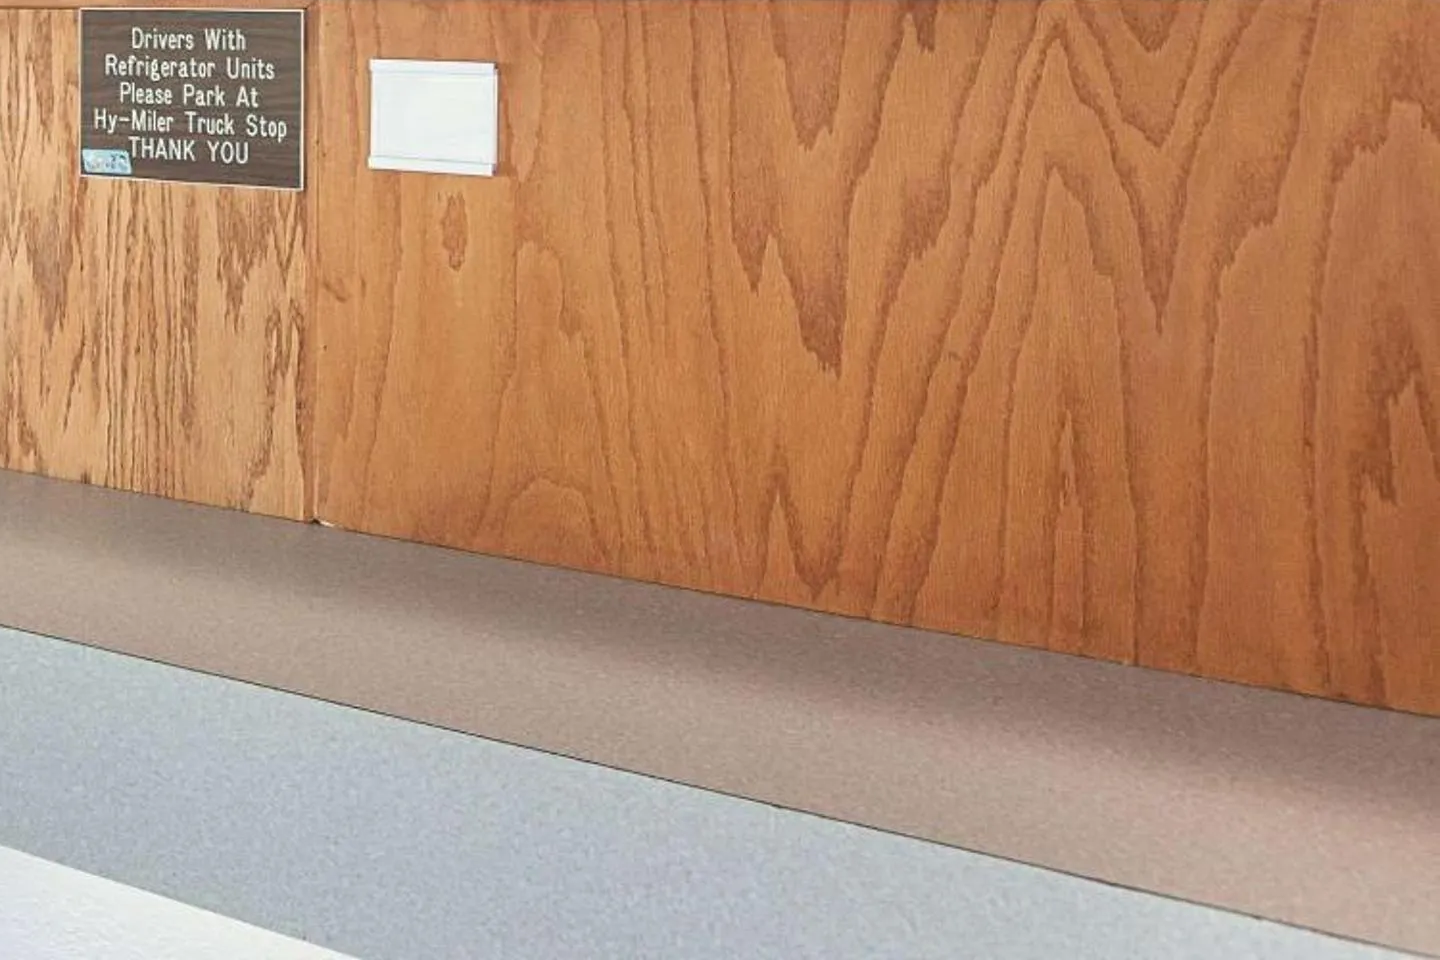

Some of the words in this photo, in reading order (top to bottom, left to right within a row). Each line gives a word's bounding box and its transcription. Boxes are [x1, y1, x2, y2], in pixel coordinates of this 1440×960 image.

[131, 27, 195, 50] Drivers
[204, 28, 247, 51] With
[104, 54, 216, 81] Refrigerator
[226, 57, 276, 80] Units
[120, 82, 173, 104] Please
[183, 84, 225, 107] Park
[235, 86, 259, 108] At
[93, 108, 174, 134] Hy-Miler
[184, 111, 235, 135] Truck
[246, 114, 287, 142] Stop
[128, 136, 196, 161] THANK
[207, 141, 249, 165] YOU
